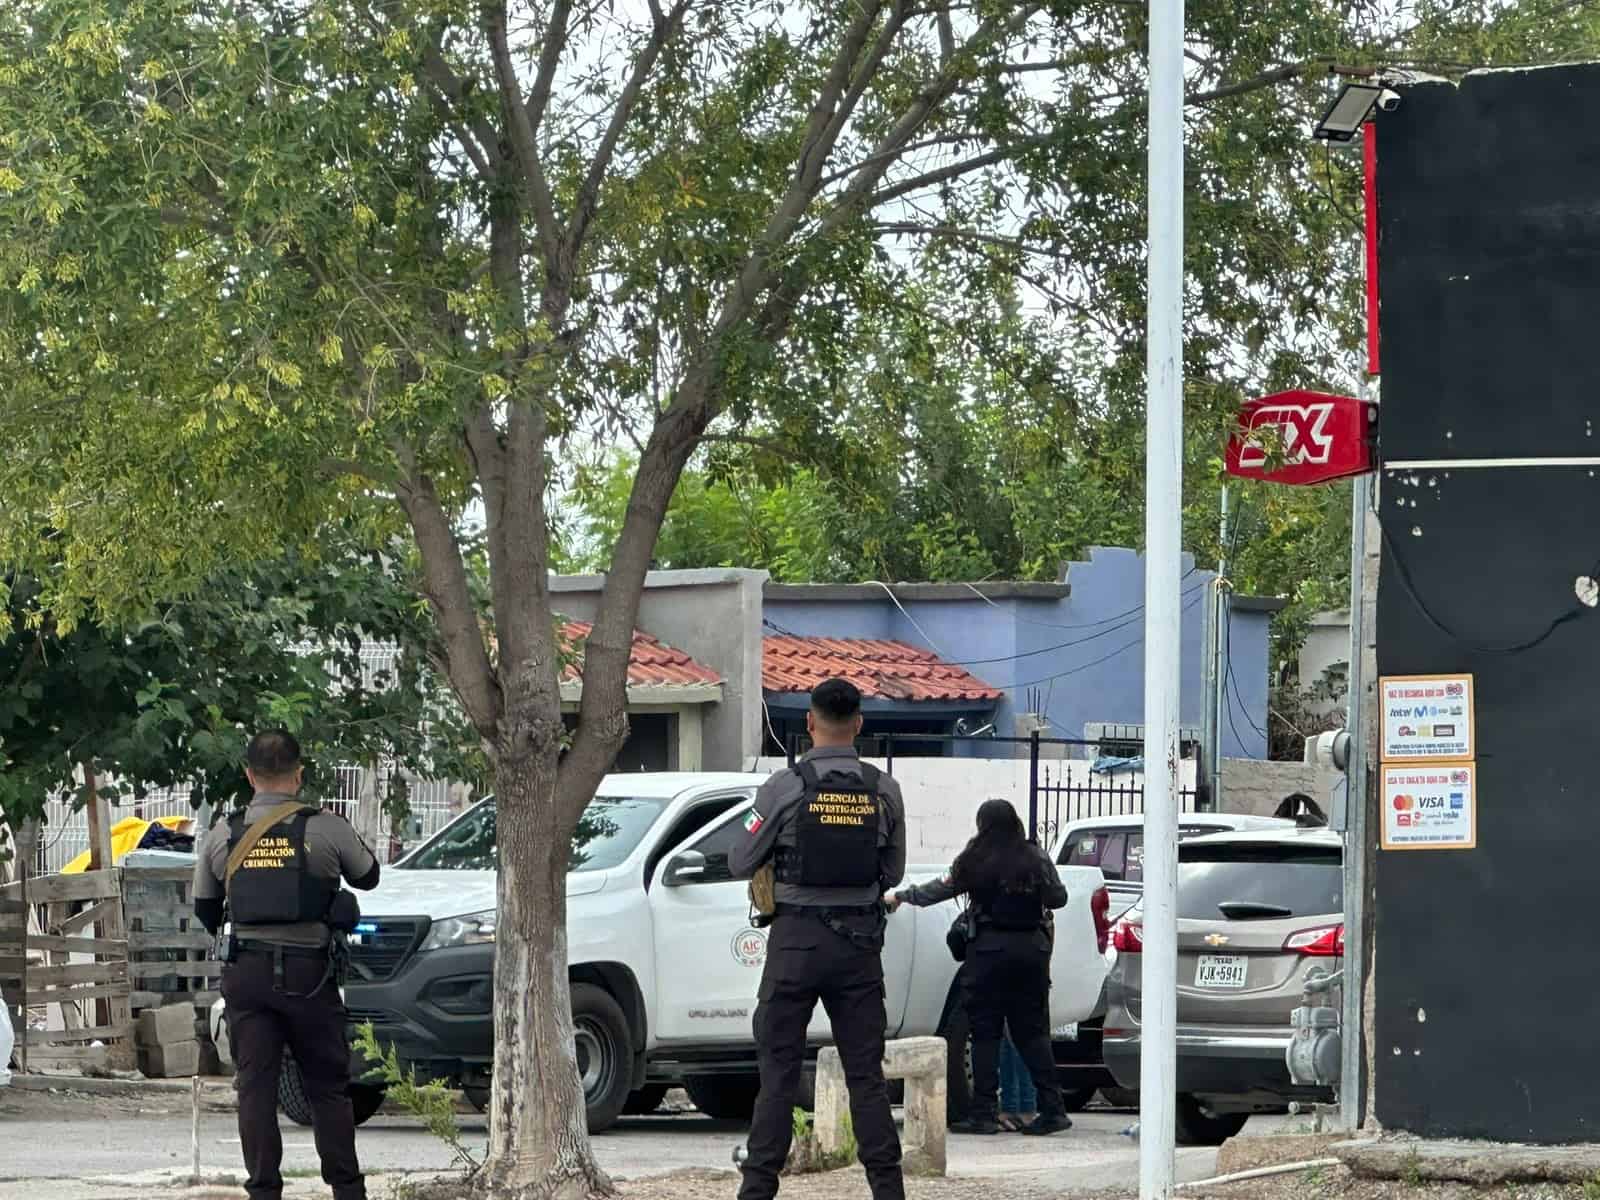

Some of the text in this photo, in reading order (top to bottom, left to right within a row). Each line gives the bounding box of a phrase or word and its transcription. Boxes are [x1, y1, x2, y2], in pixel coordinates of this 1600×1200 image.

[816, 793, 870, 804] AGENCIA DE
[1419, 796, 1445, 808] VISA
[808, 803, 876, 815] INVESTIGACIÓN
[820, 814, 864, 825] CRIMINAL
[276, 838, 289, 847] DE
[242, 859, 285, 869] CRIMINAL
